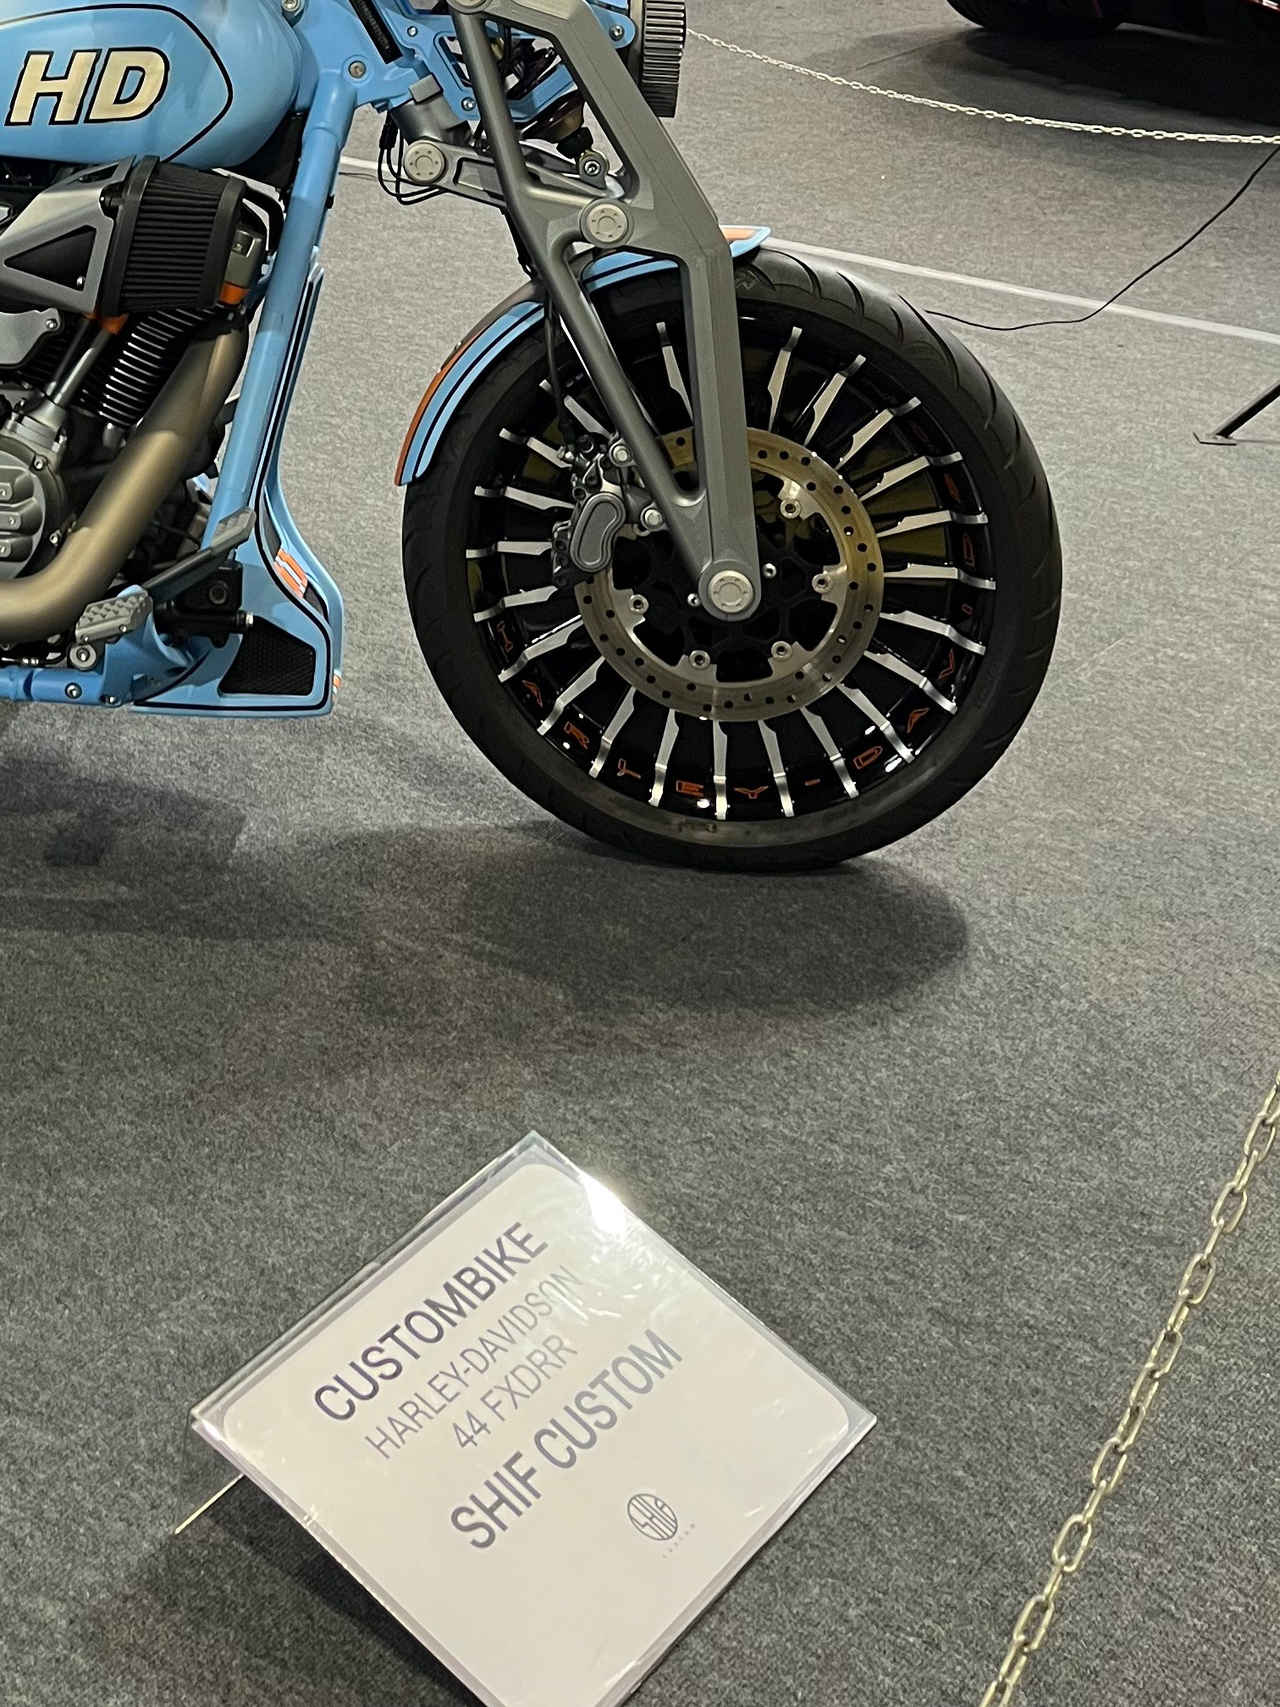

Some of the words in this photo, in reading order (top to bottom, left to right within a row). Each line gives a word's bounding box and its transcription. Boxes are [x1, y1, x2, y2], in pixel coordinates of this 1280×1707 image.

[4, 46, 171, 126] HD
[312, 1221, 550, 1422] CUSTOMBIKE
[364, 1264, 585, 1461] HARLEY-DAVIDSON
[451, 1411, 493, 1451] 44
[483, 1333, 579, 1421] FXDRR
[448, 1450, 545, 1550] SHIF
[532, 1329, 684, 1470] CUSTOM
